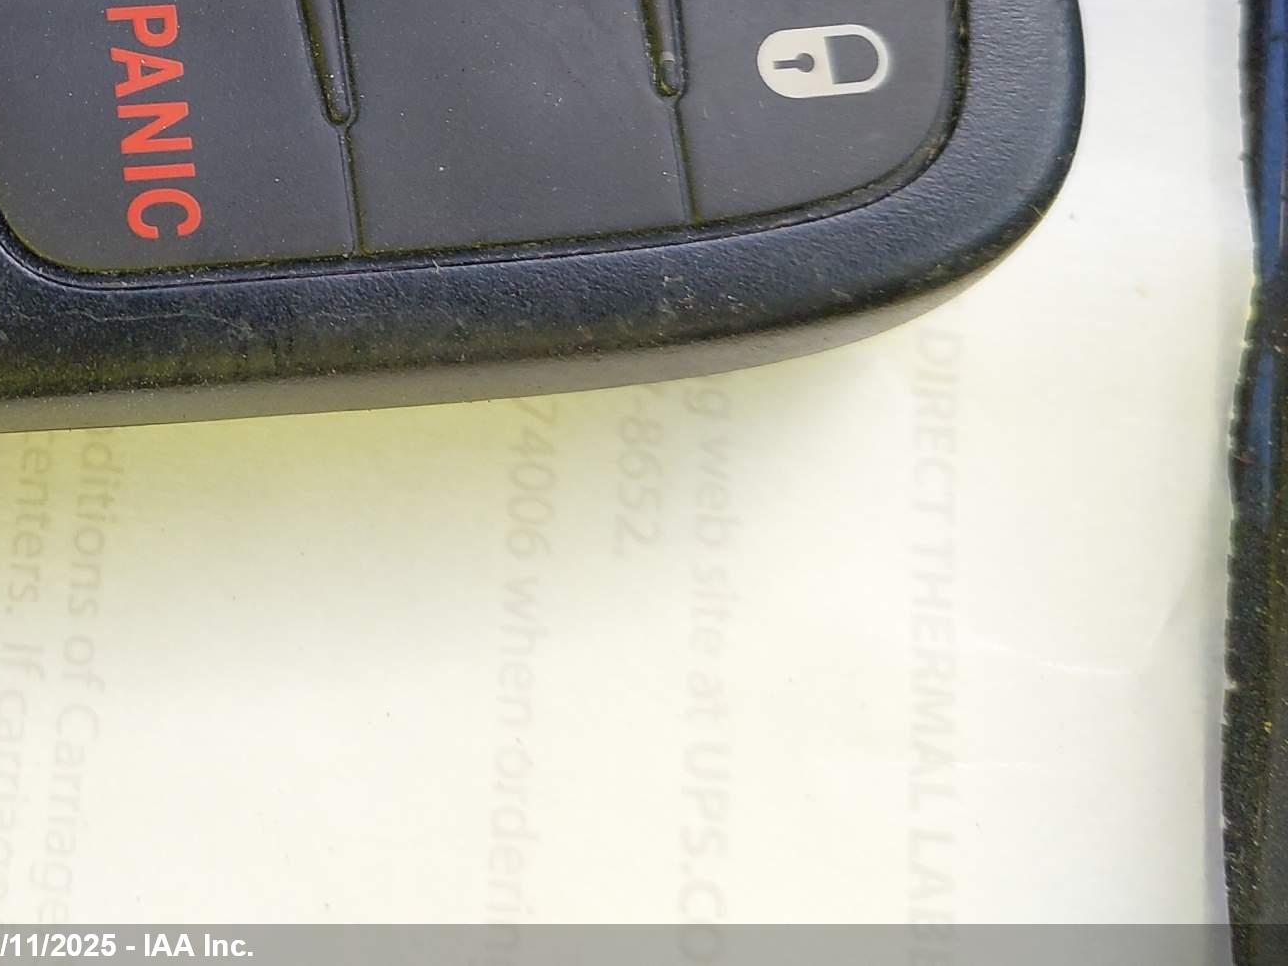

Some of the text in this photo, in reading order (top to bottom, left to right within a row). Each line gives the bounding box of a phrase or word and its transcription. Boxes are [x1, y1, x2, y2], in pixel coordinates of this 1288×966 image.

[106, 4, 203, 240] PANIC
[694, 435, 746, 551] web
[911, 327, 962, 525] DIRECT
[0, 641, 47, 682] If
[61, 634, 106, 694] of
[495, 575, 550, 729] when
[688, 564, 742, 659] site
[907, 537, 957, 814] THERMAL
[684, 669, 733, 723] at
[29, 701, 102, 924] Carriage
